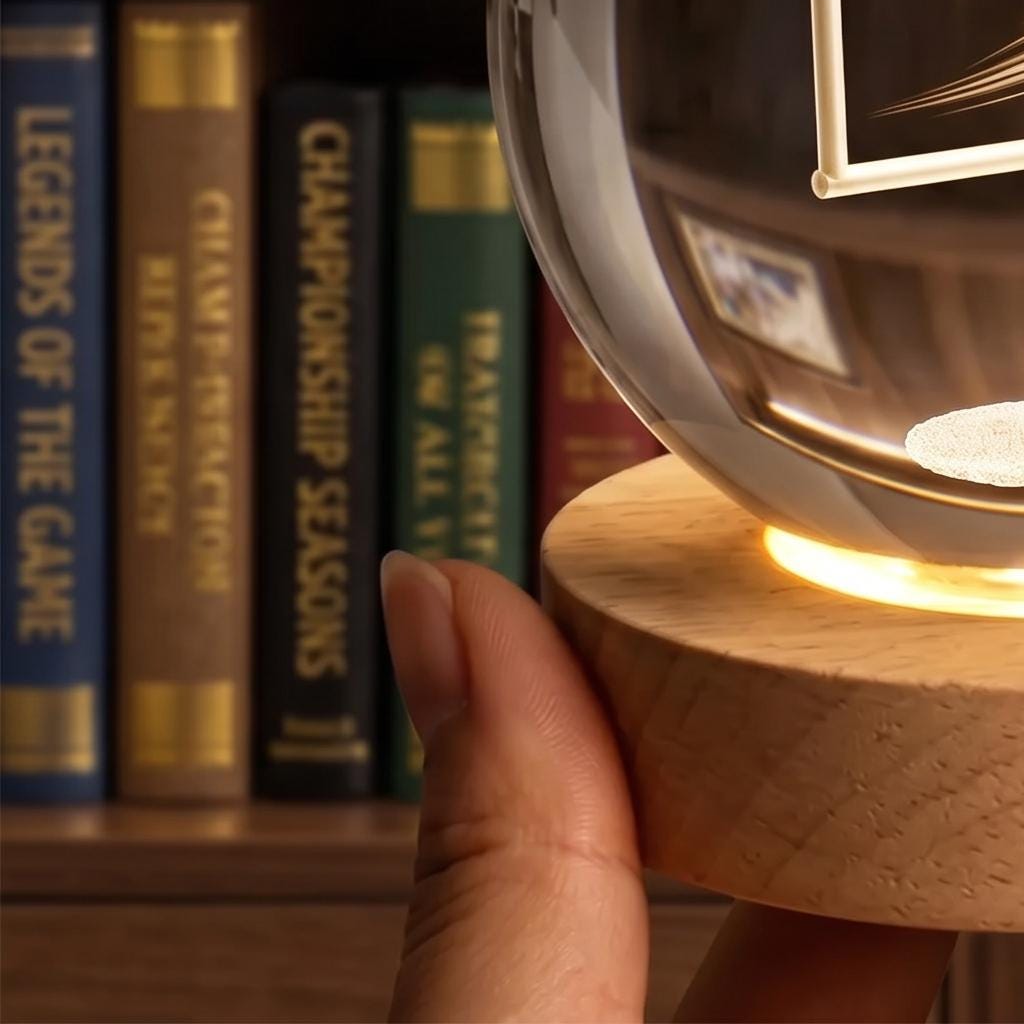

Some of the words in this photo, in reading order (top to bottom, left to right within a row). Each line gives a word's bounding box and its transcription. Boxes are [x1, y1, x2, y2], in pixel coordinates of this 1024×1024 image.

[18, 107, 74, 315] LEGENDS
[298, 121, 351, 467] CHAMPIONSHIP
[18, 328, 74, 389] OF
[18, 404, 74, 491] THE
[18, 504, 74, 643] GAME
[296, 478, 349, 679] SEASONS
